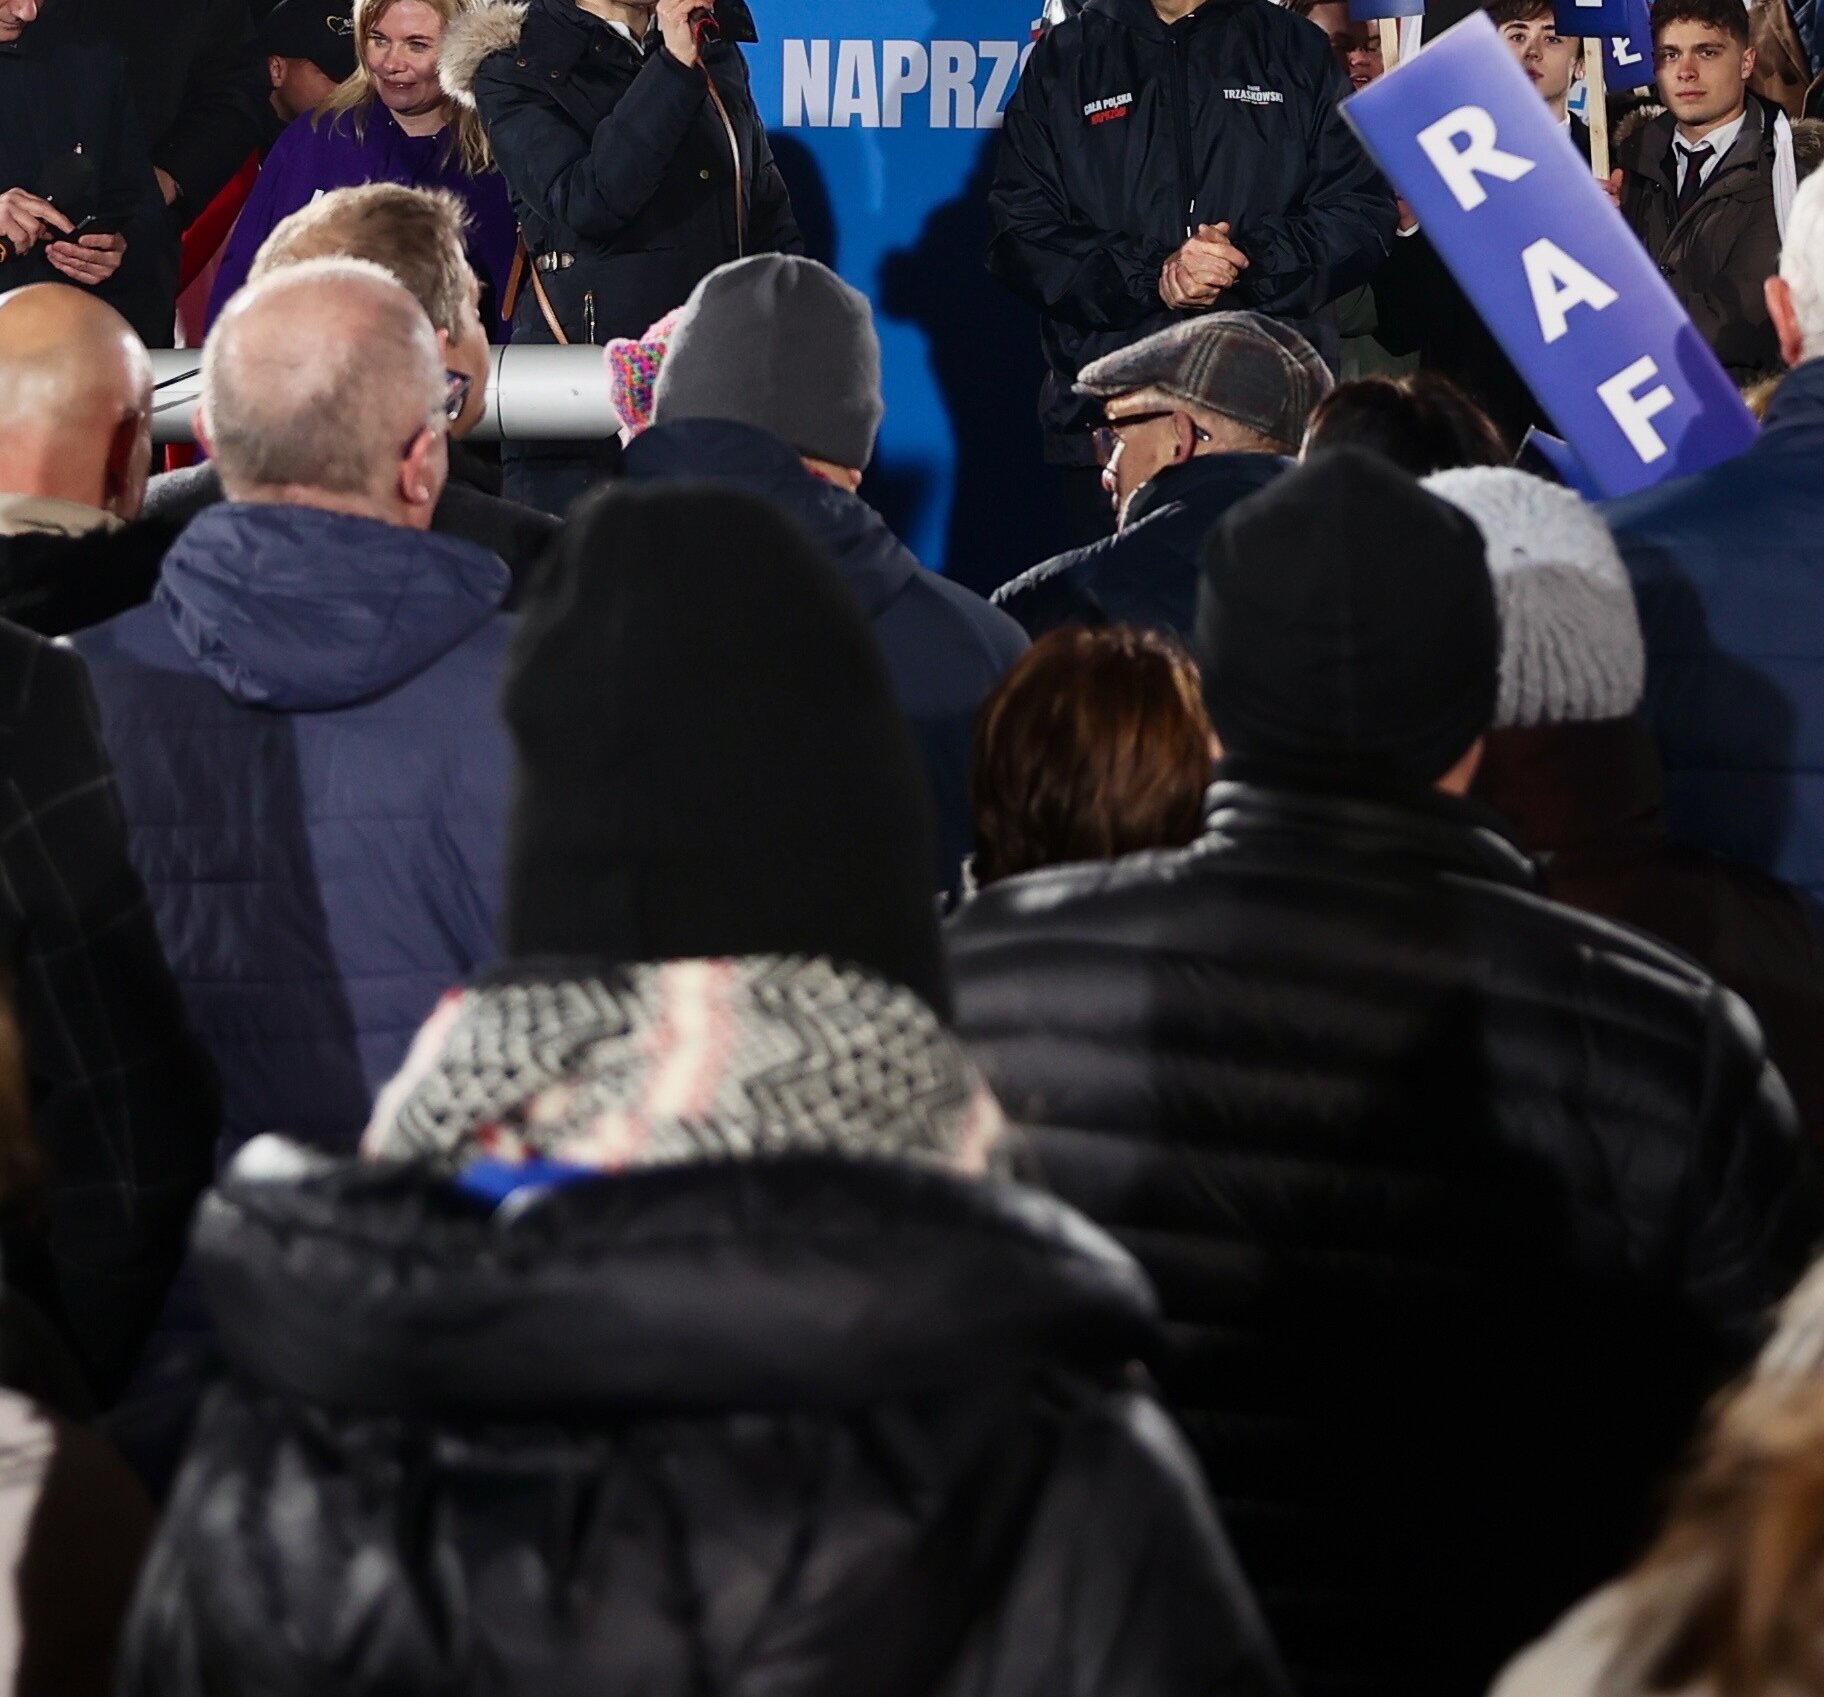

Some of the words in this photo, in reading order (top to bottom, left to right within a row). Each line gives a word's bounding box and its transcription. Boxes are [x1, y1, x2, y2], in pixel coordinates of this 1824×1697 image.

[782, 38, 1034, 129] NAPRZ
[1223, 89, 1284, 104] TRZASKOWSKI
[1416, 105, 1678, 464] RAF
